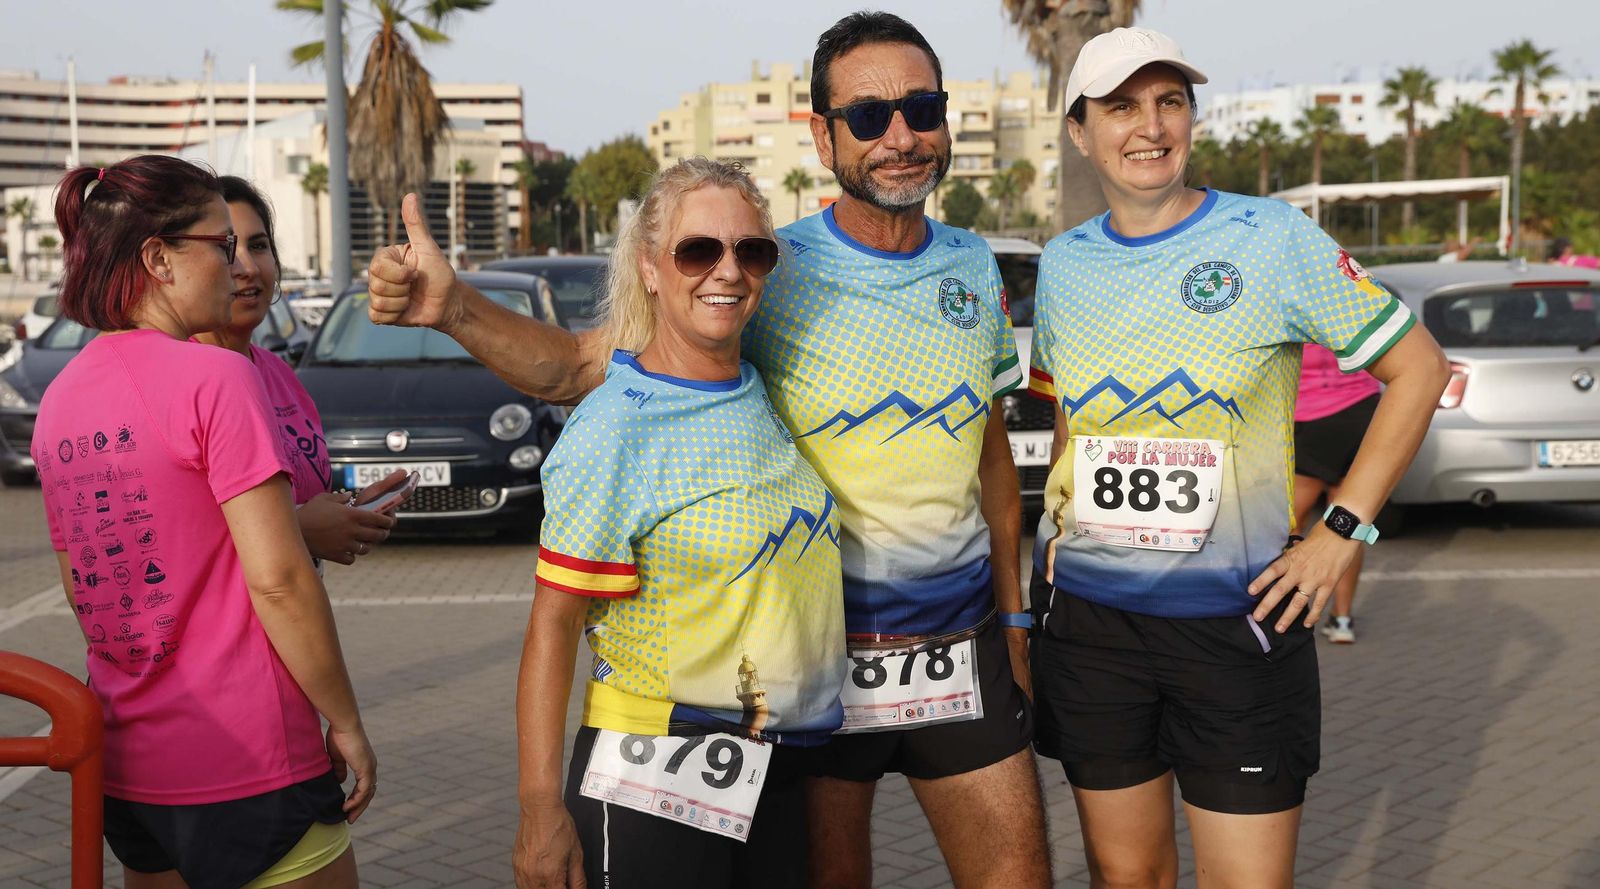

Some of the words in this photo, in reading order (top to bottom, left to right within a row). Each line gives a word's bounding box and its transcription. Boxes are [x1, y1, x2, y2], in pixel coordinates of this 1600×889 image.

[1107, 451, 1136, 464] POR
[1141, 452, 1160, 465] LA
[1164, 452, 1217, 467] MUJER
[1143, 441, 1212, 455] CARRERA
[1092, 466, 1200, 515] 883
[851, 645, 955, 689] 878
[619, 734, 744, 790] 879
